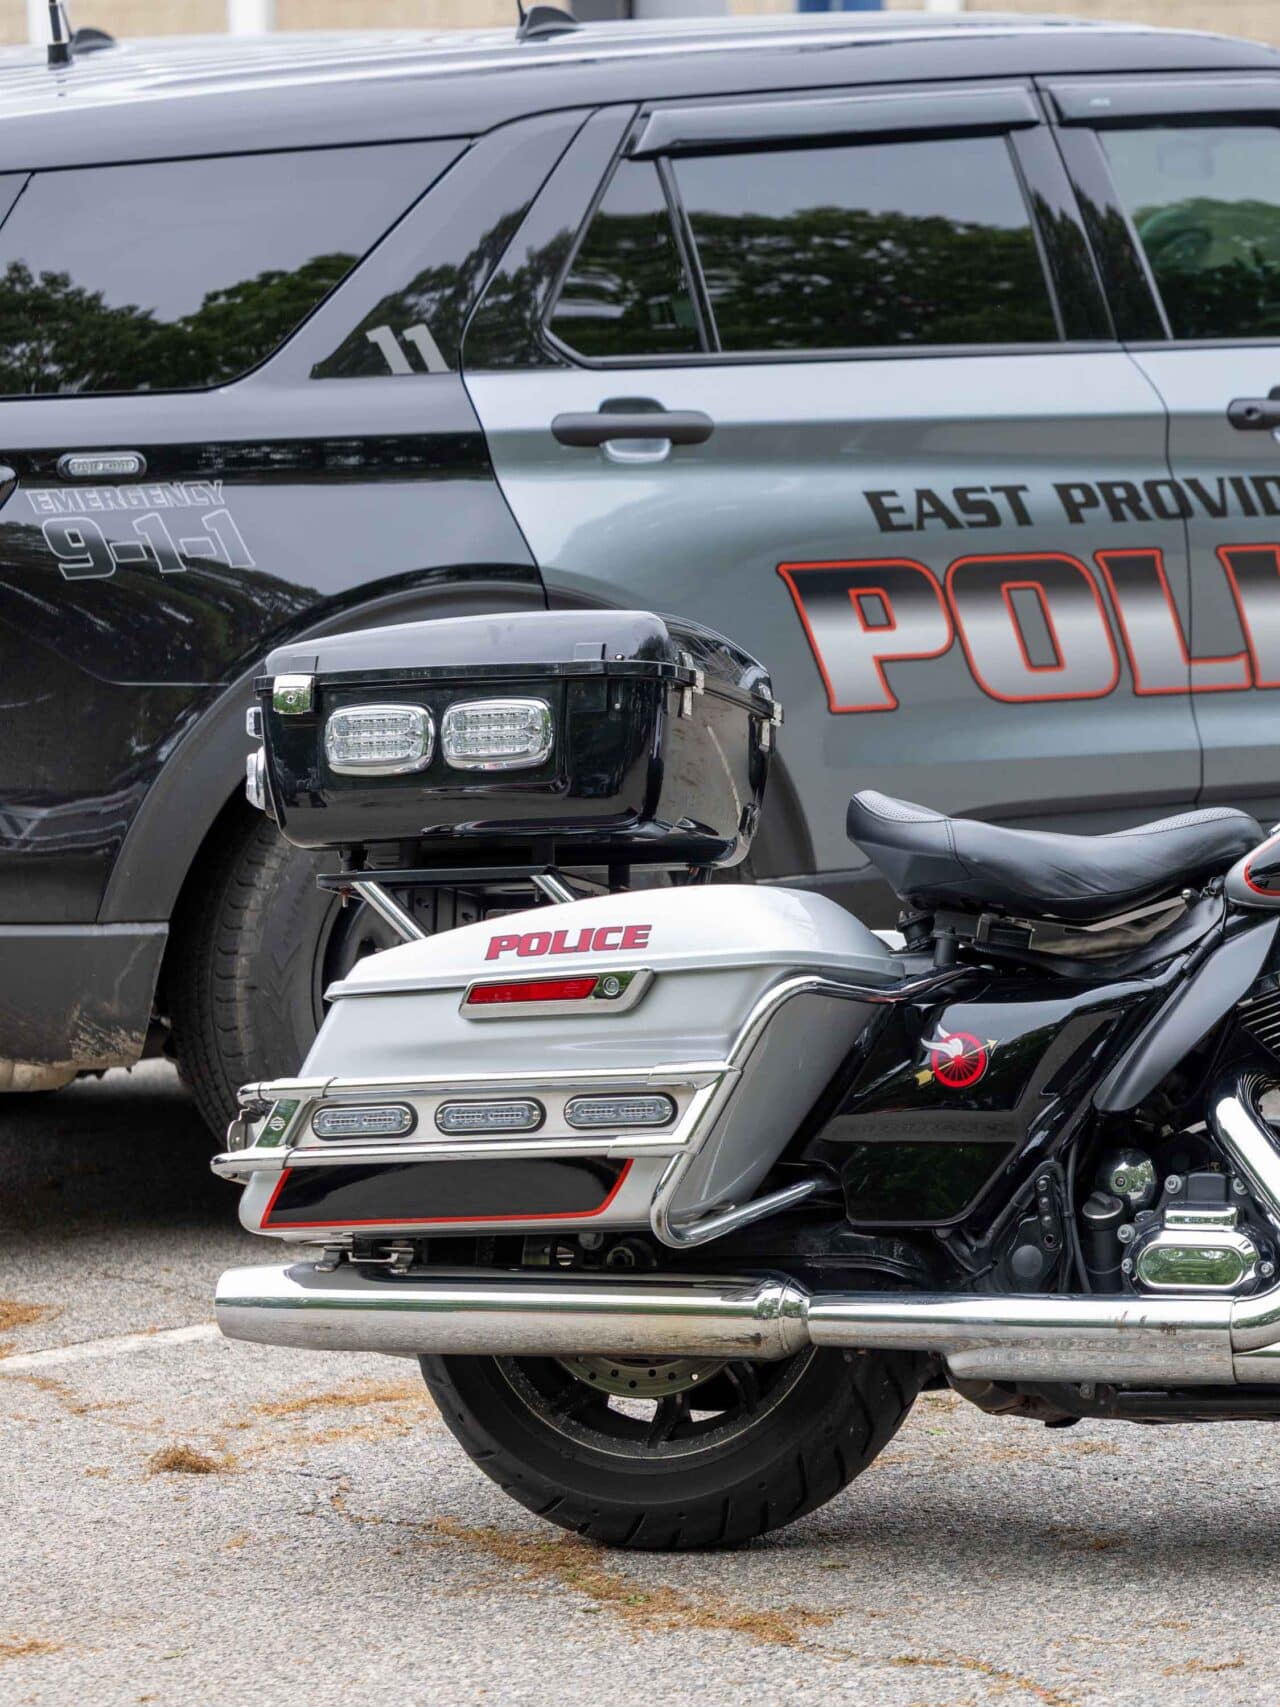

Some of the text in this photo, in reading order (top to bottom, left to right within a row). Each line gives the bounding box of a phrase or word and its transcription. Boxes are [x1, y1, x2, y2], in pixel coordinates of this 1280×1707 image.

[366, 324, 449, 374] 11
[26, 480, 225, 514] EMERGENCY
[863, 484, 1032, 532] EAST
[42, 508, 256, 581] 9-1-1
[484, 924, 652, 961] POLICE
